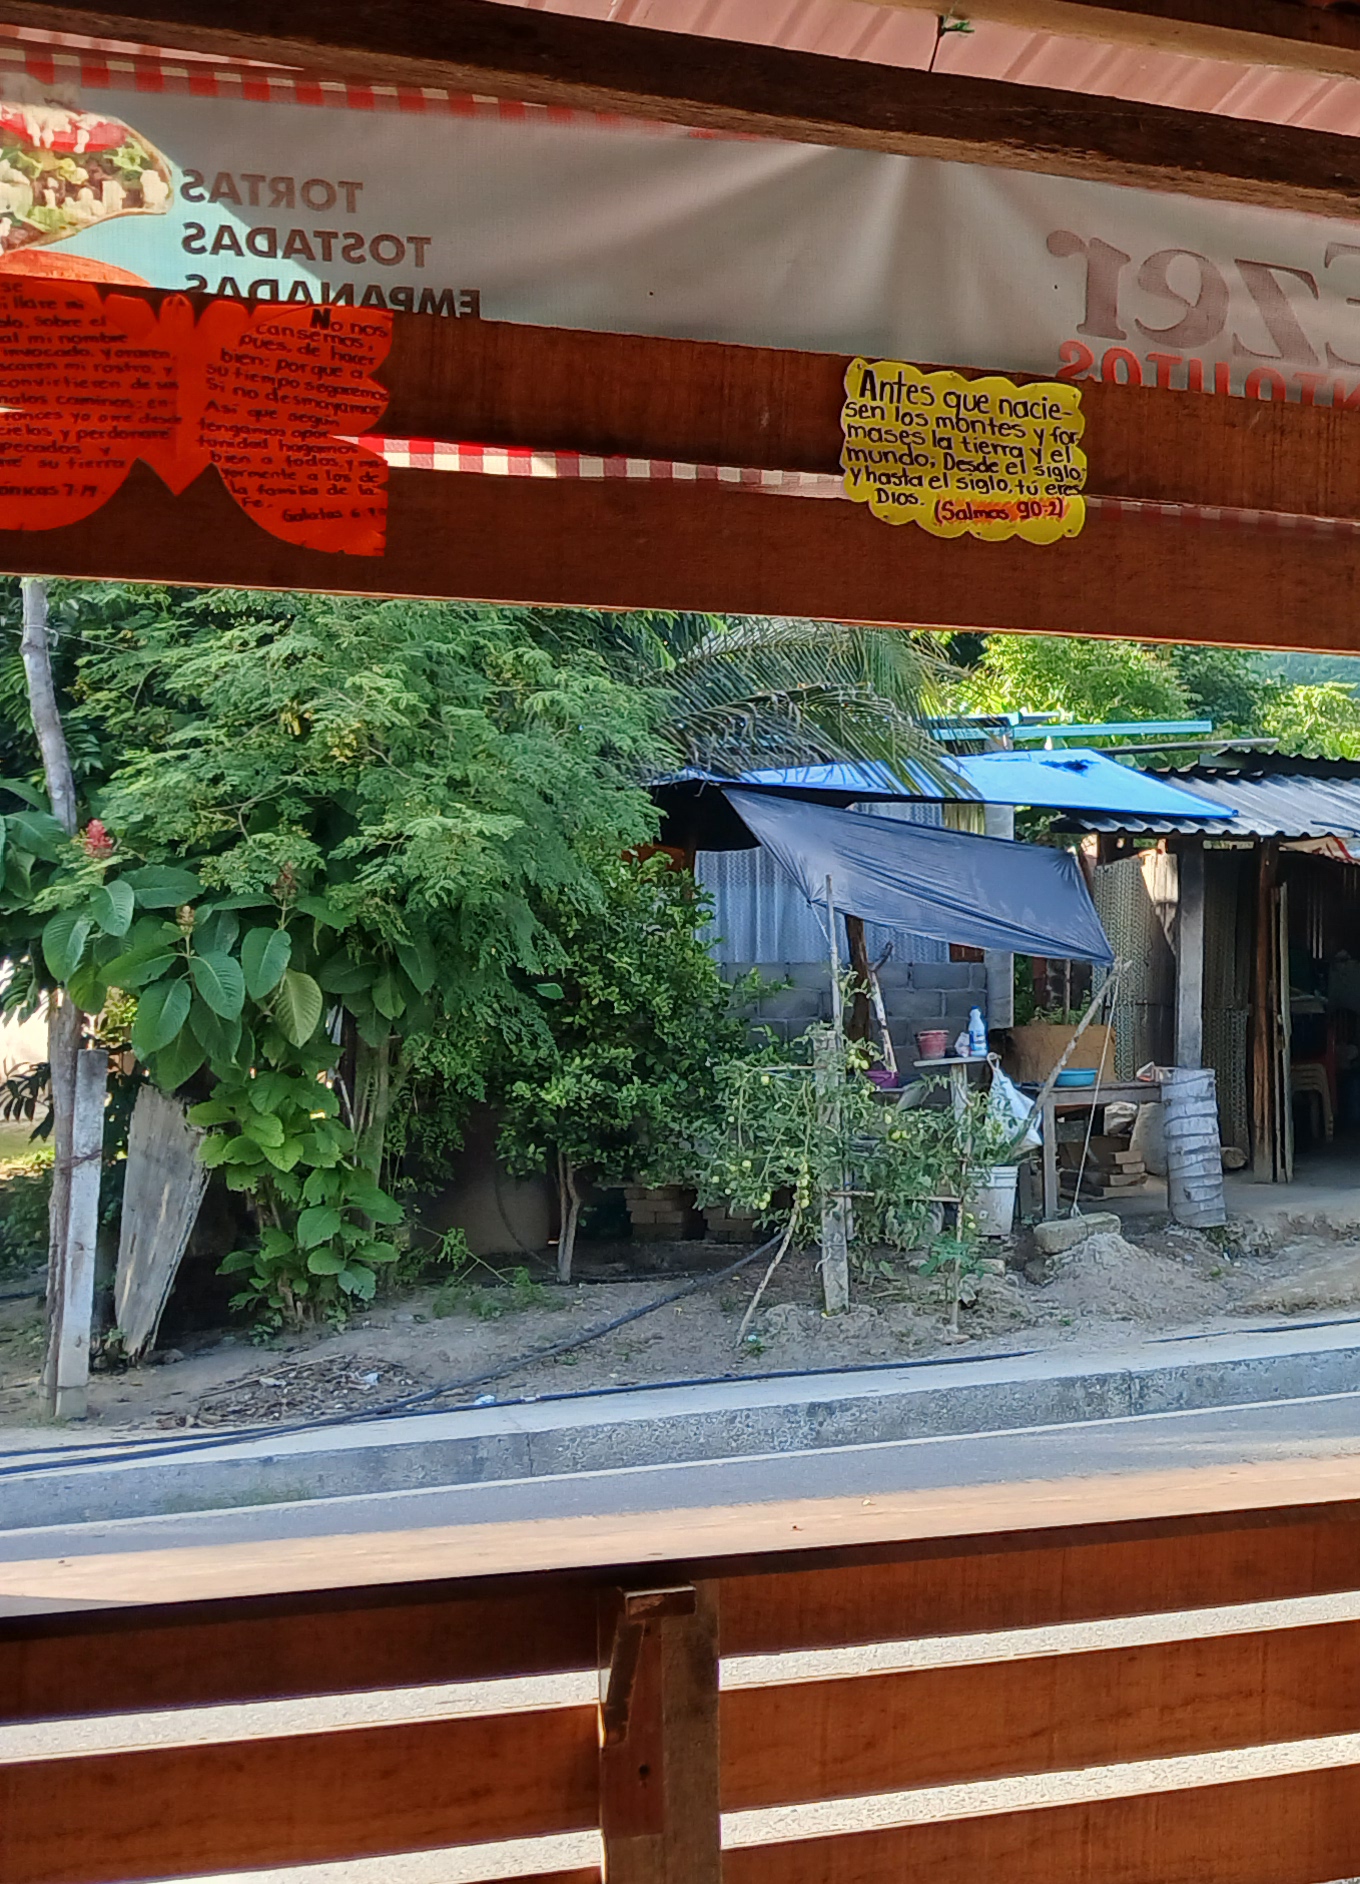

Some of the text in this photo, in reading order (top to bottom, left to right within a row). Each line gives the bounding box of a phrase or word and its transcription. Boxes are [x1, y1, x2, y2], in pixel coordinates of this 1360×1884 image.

[858, 368, 1073, 420] Antes que nacie-
[845, 401, 885, 421] sen
[895, 405, 928, 427] los
[935, 416, 1027, 439] montes
[1033, 428, 1046, 447] y
[847, 423, 1071, 464] mases la tierra y el
[864, 465, 924, 487] hasta
[928, 472, 949, 489] el
[1015, 480, 1039, 496] tú
[1045, 484, 1081, 496] eres
[943, 452, 999, 474] Desde
[1005, 458, 1027, 475] el
